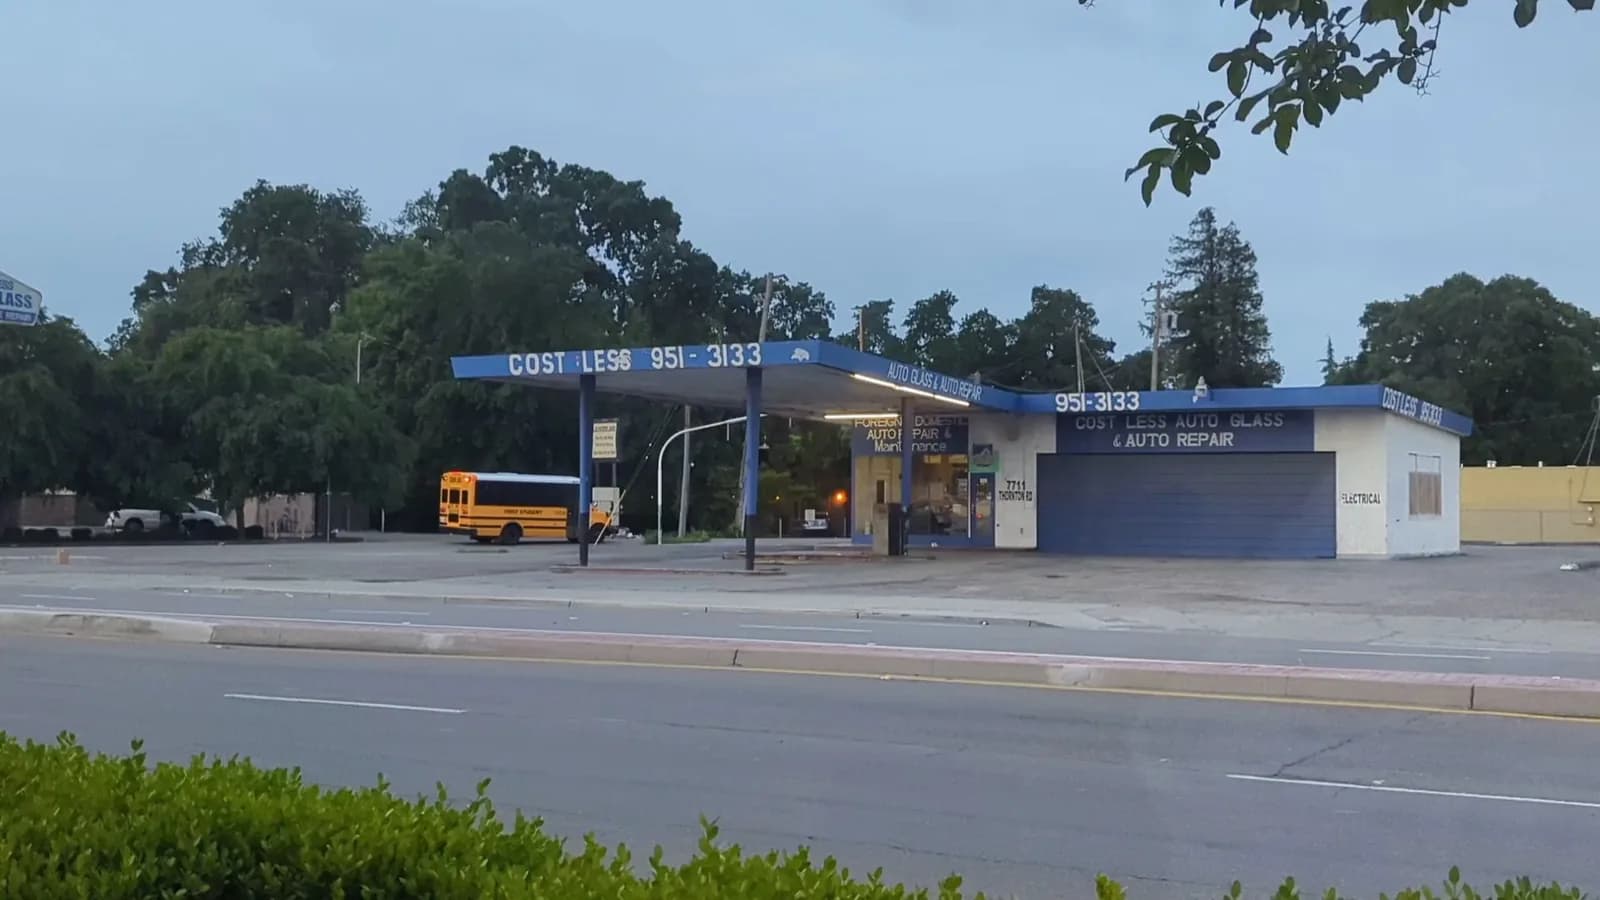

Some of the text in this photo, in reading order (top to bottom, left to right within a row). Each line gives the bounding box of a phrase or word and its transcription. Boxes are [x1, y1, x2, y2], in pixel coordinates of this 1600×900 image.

[508, 351, 566, 377] COST
[581, 349, 632, 373] LESS
[887, 361, 909, 382] AUTO
[910, 368, 933, 388] GLASS
[932, 376, 938, 390] &
[939, 376, 958, 395] AUTO
[1055, 391, 1140, 412] 951-3133
[854, 416, 903, 428] FOREIGN
[1075, 412, 1284, 430] COST LESS AUTO GLASS
[866, 428, 895, 440] AUTO
[1112, 431, 1234, 448] & AUTO REPAIR
[1006, 480, 1025, 491] 7711
[1341, 492, 1381, 505] ELECTRICAL
